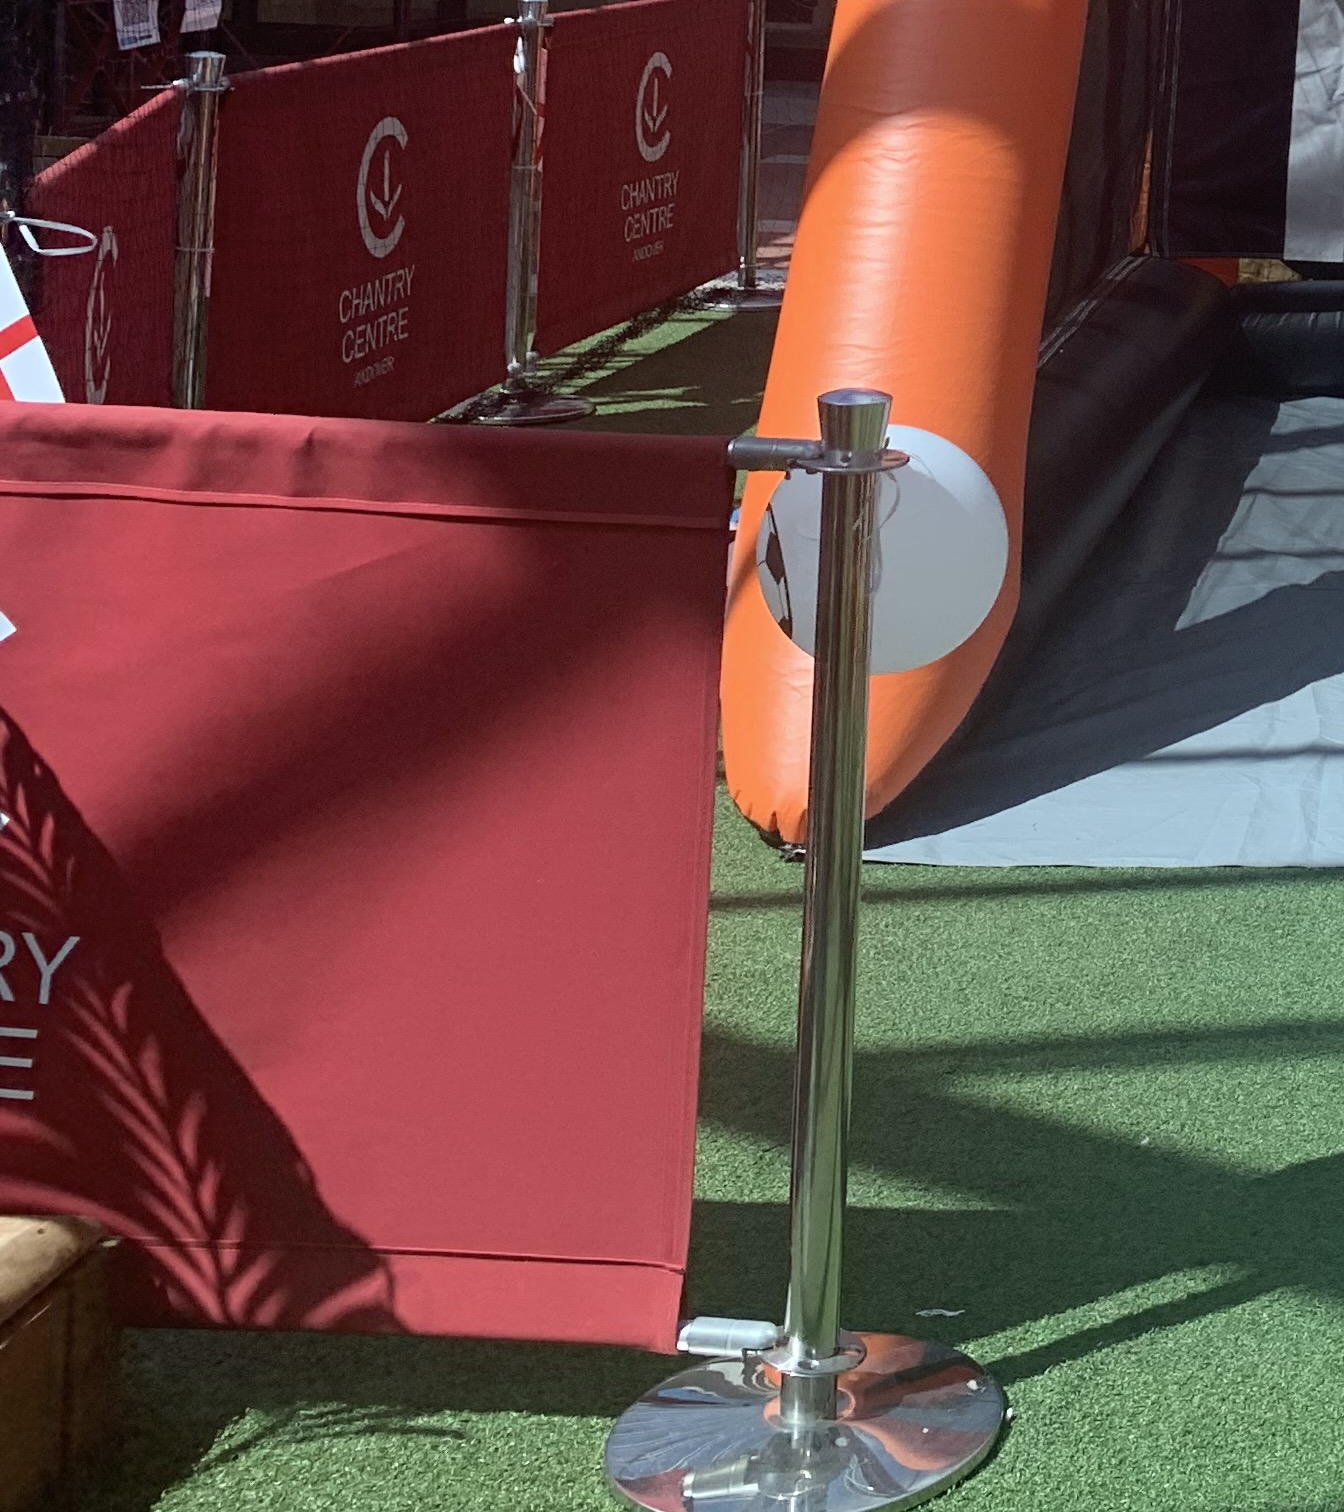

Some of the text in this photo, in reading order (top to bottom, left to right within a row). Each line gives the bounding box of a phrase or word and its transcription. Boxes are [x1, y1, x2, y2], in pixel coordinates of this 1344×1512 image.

[620, 168, 680, 211] CHANTRY
[624, 202, 675, 243] CENTRE
[338, 265, 416, 324] CHANTRY
[342, 306, 409, 364] CENTRE
